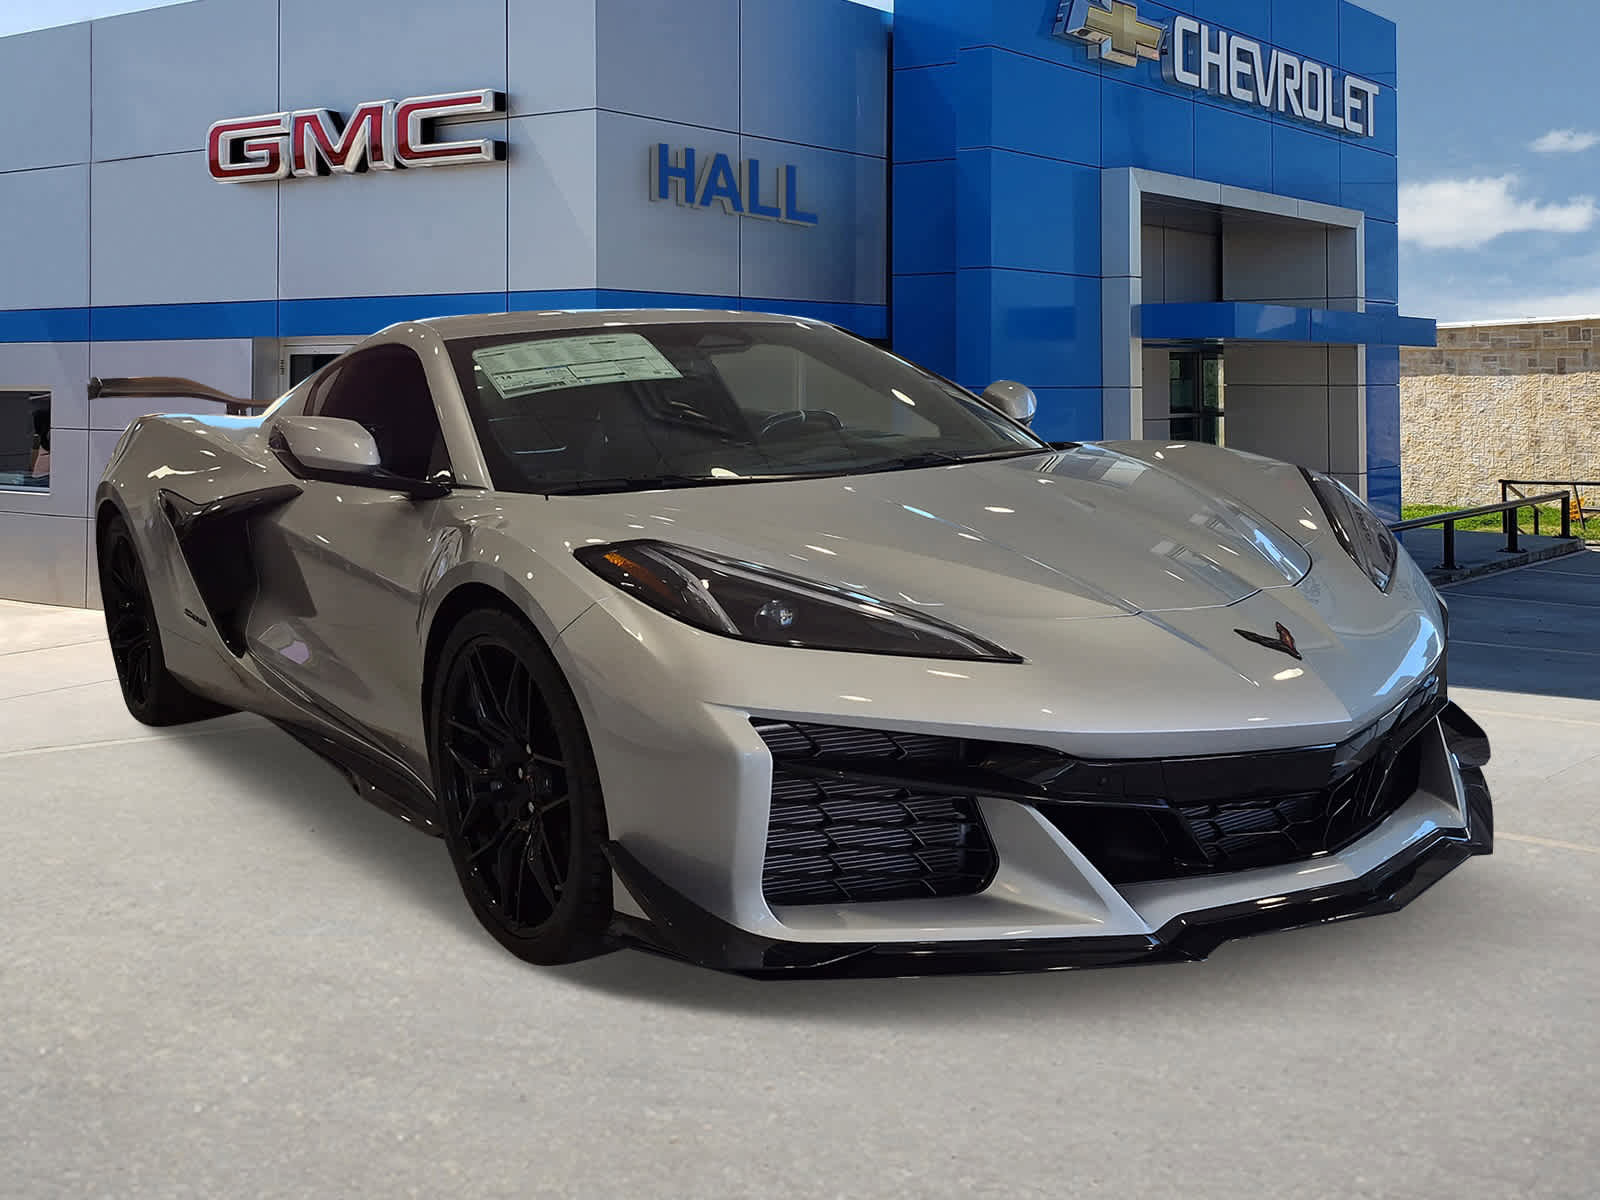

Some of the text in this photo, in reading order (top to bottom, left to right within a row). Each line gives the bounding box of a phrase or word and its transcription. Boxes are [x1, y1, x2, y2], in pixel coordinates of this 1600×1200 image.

[1173, 15, 1380, 137] CHEVROLET
[207, 88, 503, 184] GMC
[654, 143, 819, 226] HALL
